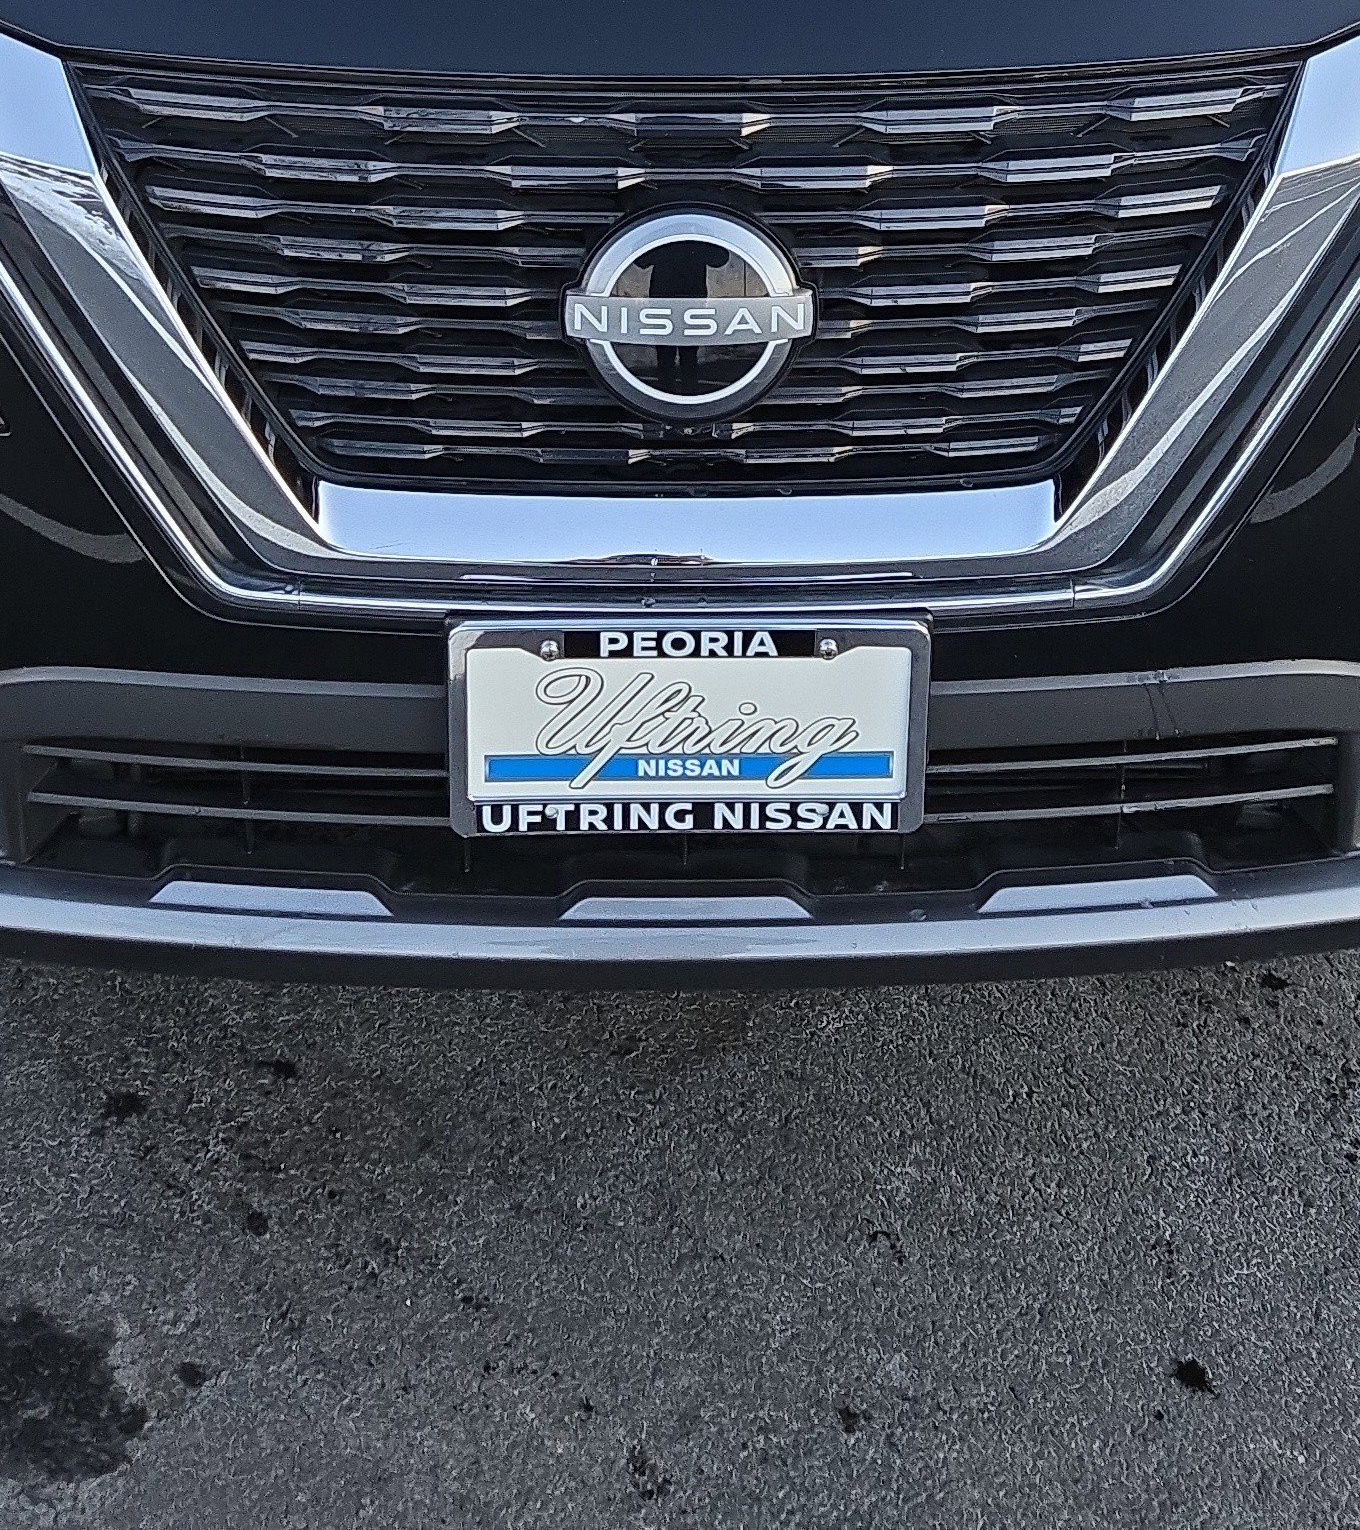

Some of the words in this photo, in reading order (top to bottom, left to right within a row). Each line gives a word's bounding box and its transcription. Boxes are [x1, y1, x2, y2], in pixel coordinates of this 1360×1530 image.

[574, 303, 804, 336] NISSAN
[600, 631, 778, 657] PEORIA
[536, 667, 859, 788] Uftring
[637, 759, 740, 777] NISSAN
[481, 803, 694, 832] UFTRING
[714, 802, 892, 830] NISSAN
